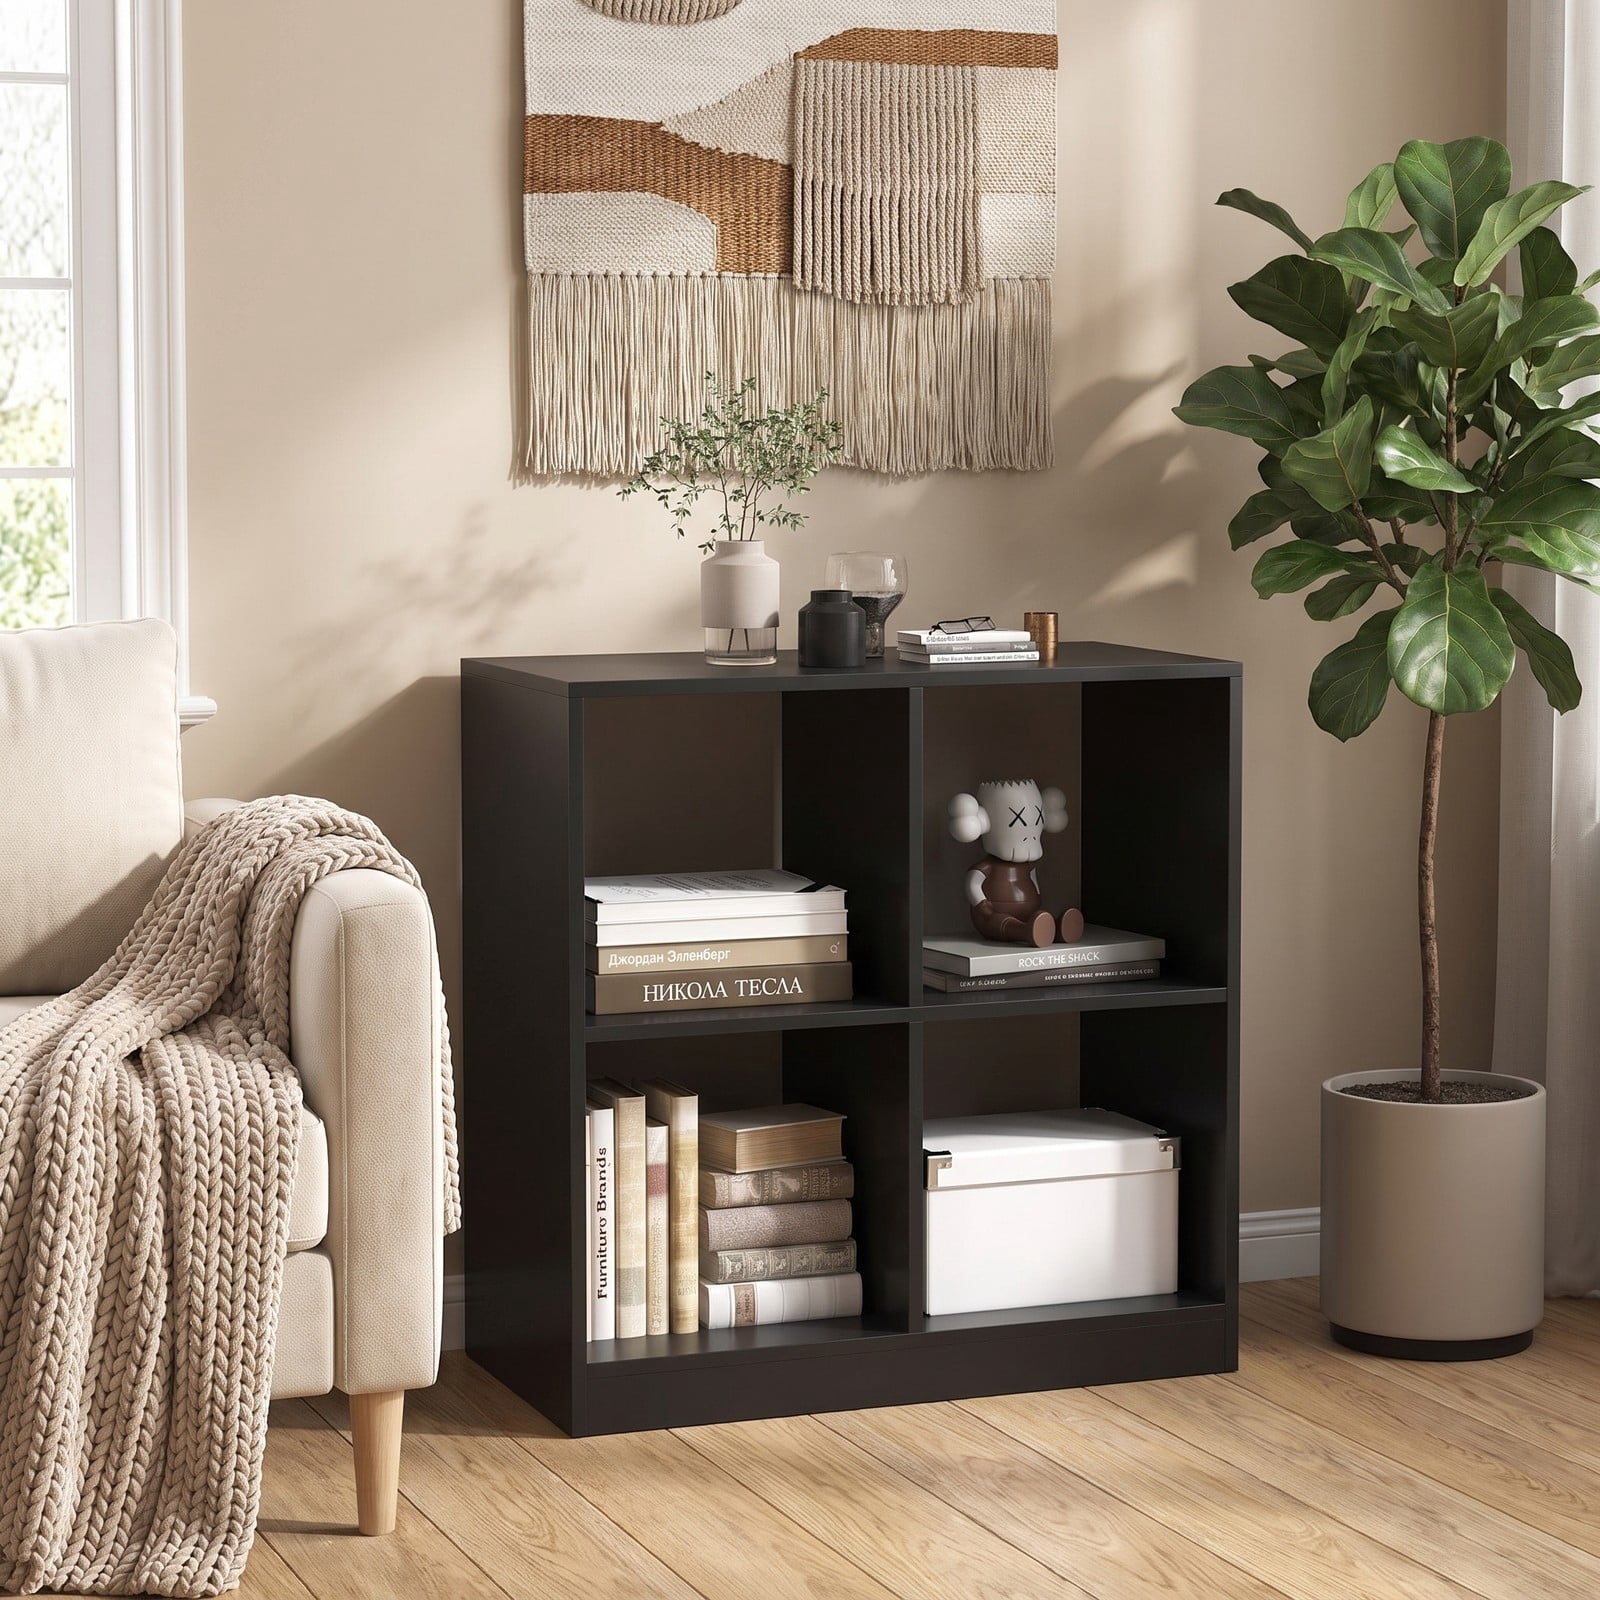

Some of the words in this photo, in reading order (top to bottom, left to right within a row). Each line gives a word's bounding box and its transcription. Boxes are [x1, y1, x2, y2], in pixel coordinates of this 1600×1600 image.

[608, 950, 664, 968] Джордан
[667, 948, 731, 966] Элленберг
[1018, 957, 1045, 969] ROCK
[1048, 954, 1067, 966] THE
[1068, 951, 1100, 964] SHACK
[643, 981, 729, 1003] НИКОЛА
[735, 976, 804, 998] ТЕСЛА
[596, 1147, 608, 1212] Brands
